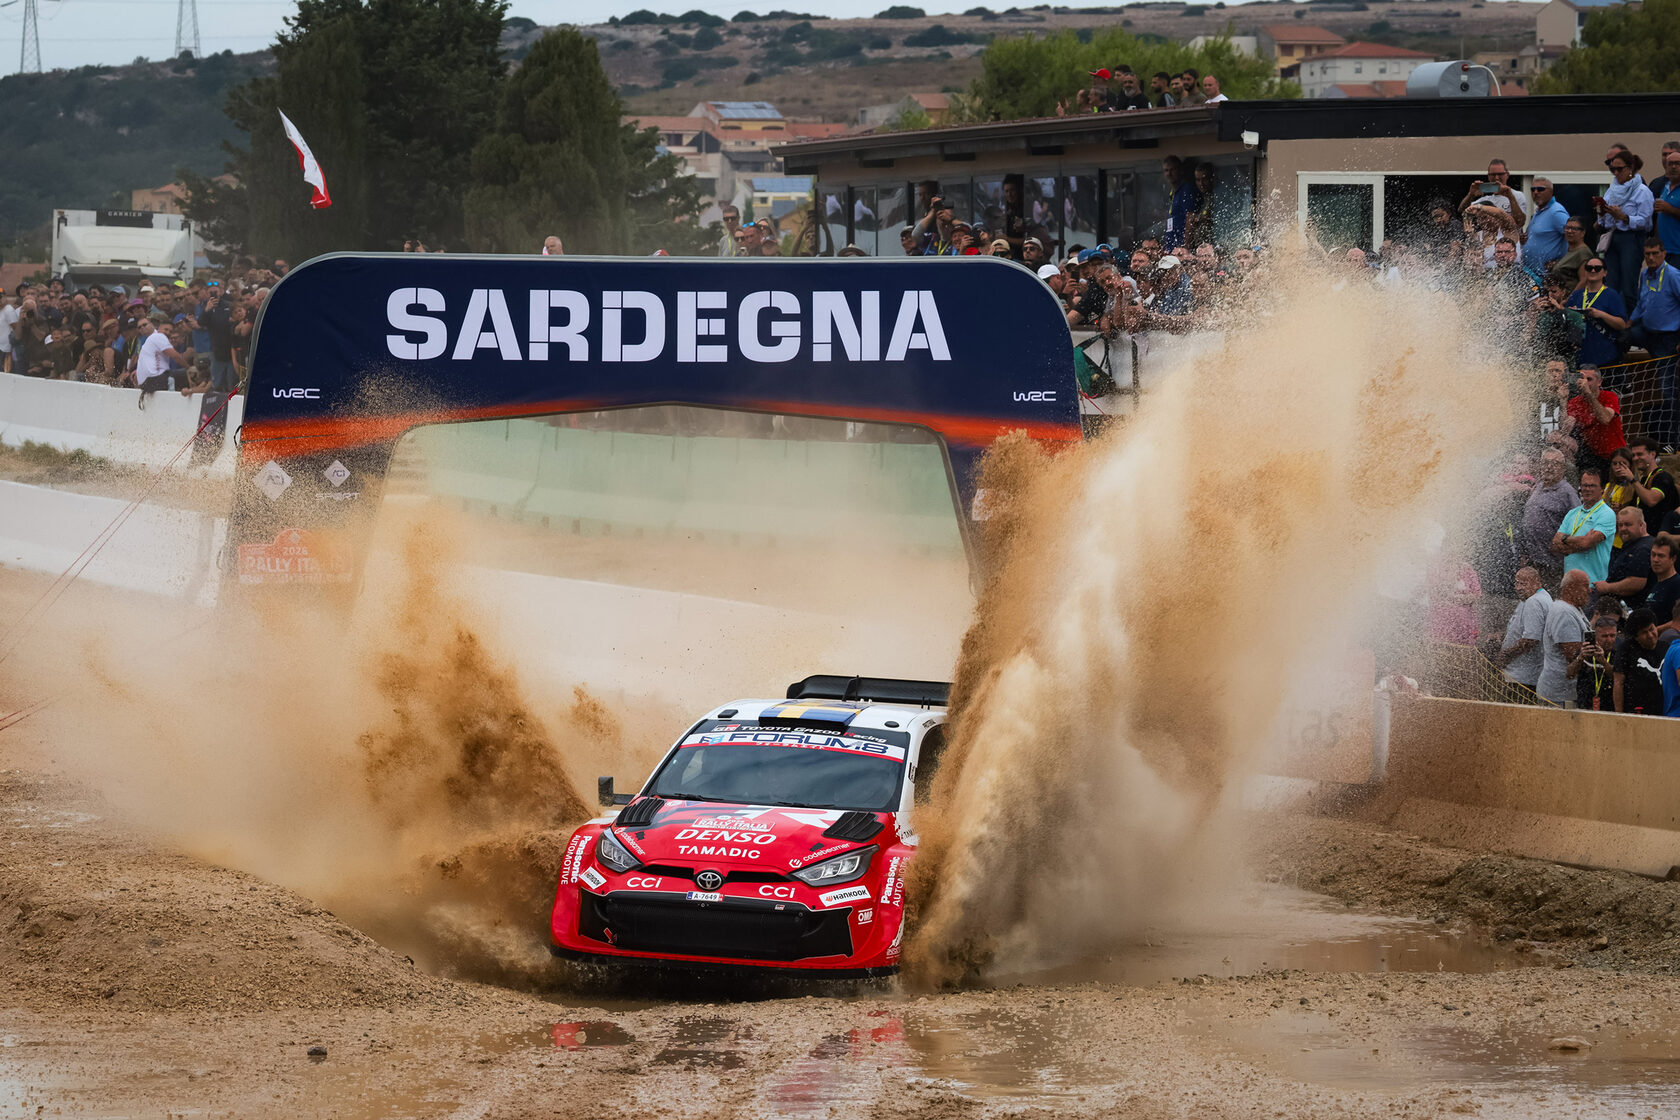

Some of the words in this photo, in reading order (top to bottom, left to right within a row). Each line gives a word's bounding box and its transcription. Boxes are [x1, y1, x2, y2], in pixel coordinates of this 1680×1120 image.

[386, 287, 952, 363] SARDEGNA
[272, 388, 321, 400] WRC
[1012, 390, 1057, 402] WRC
[740, 725, 792, 733] TOYOTA
[728, 733, 889, 755] FORUM8
[674, 829, 777, 845] DENSO
[560, 834, 582, 885] AUTOMOTIVE
[570, 835, 593, 884] Panasonic
[678, 845, 761, 860] TAMADIC
[802, 843, 850, 862] codebeamer
[880, 856, 900, 904] Panasonic
[693, 893, 718, 901] A-7649
